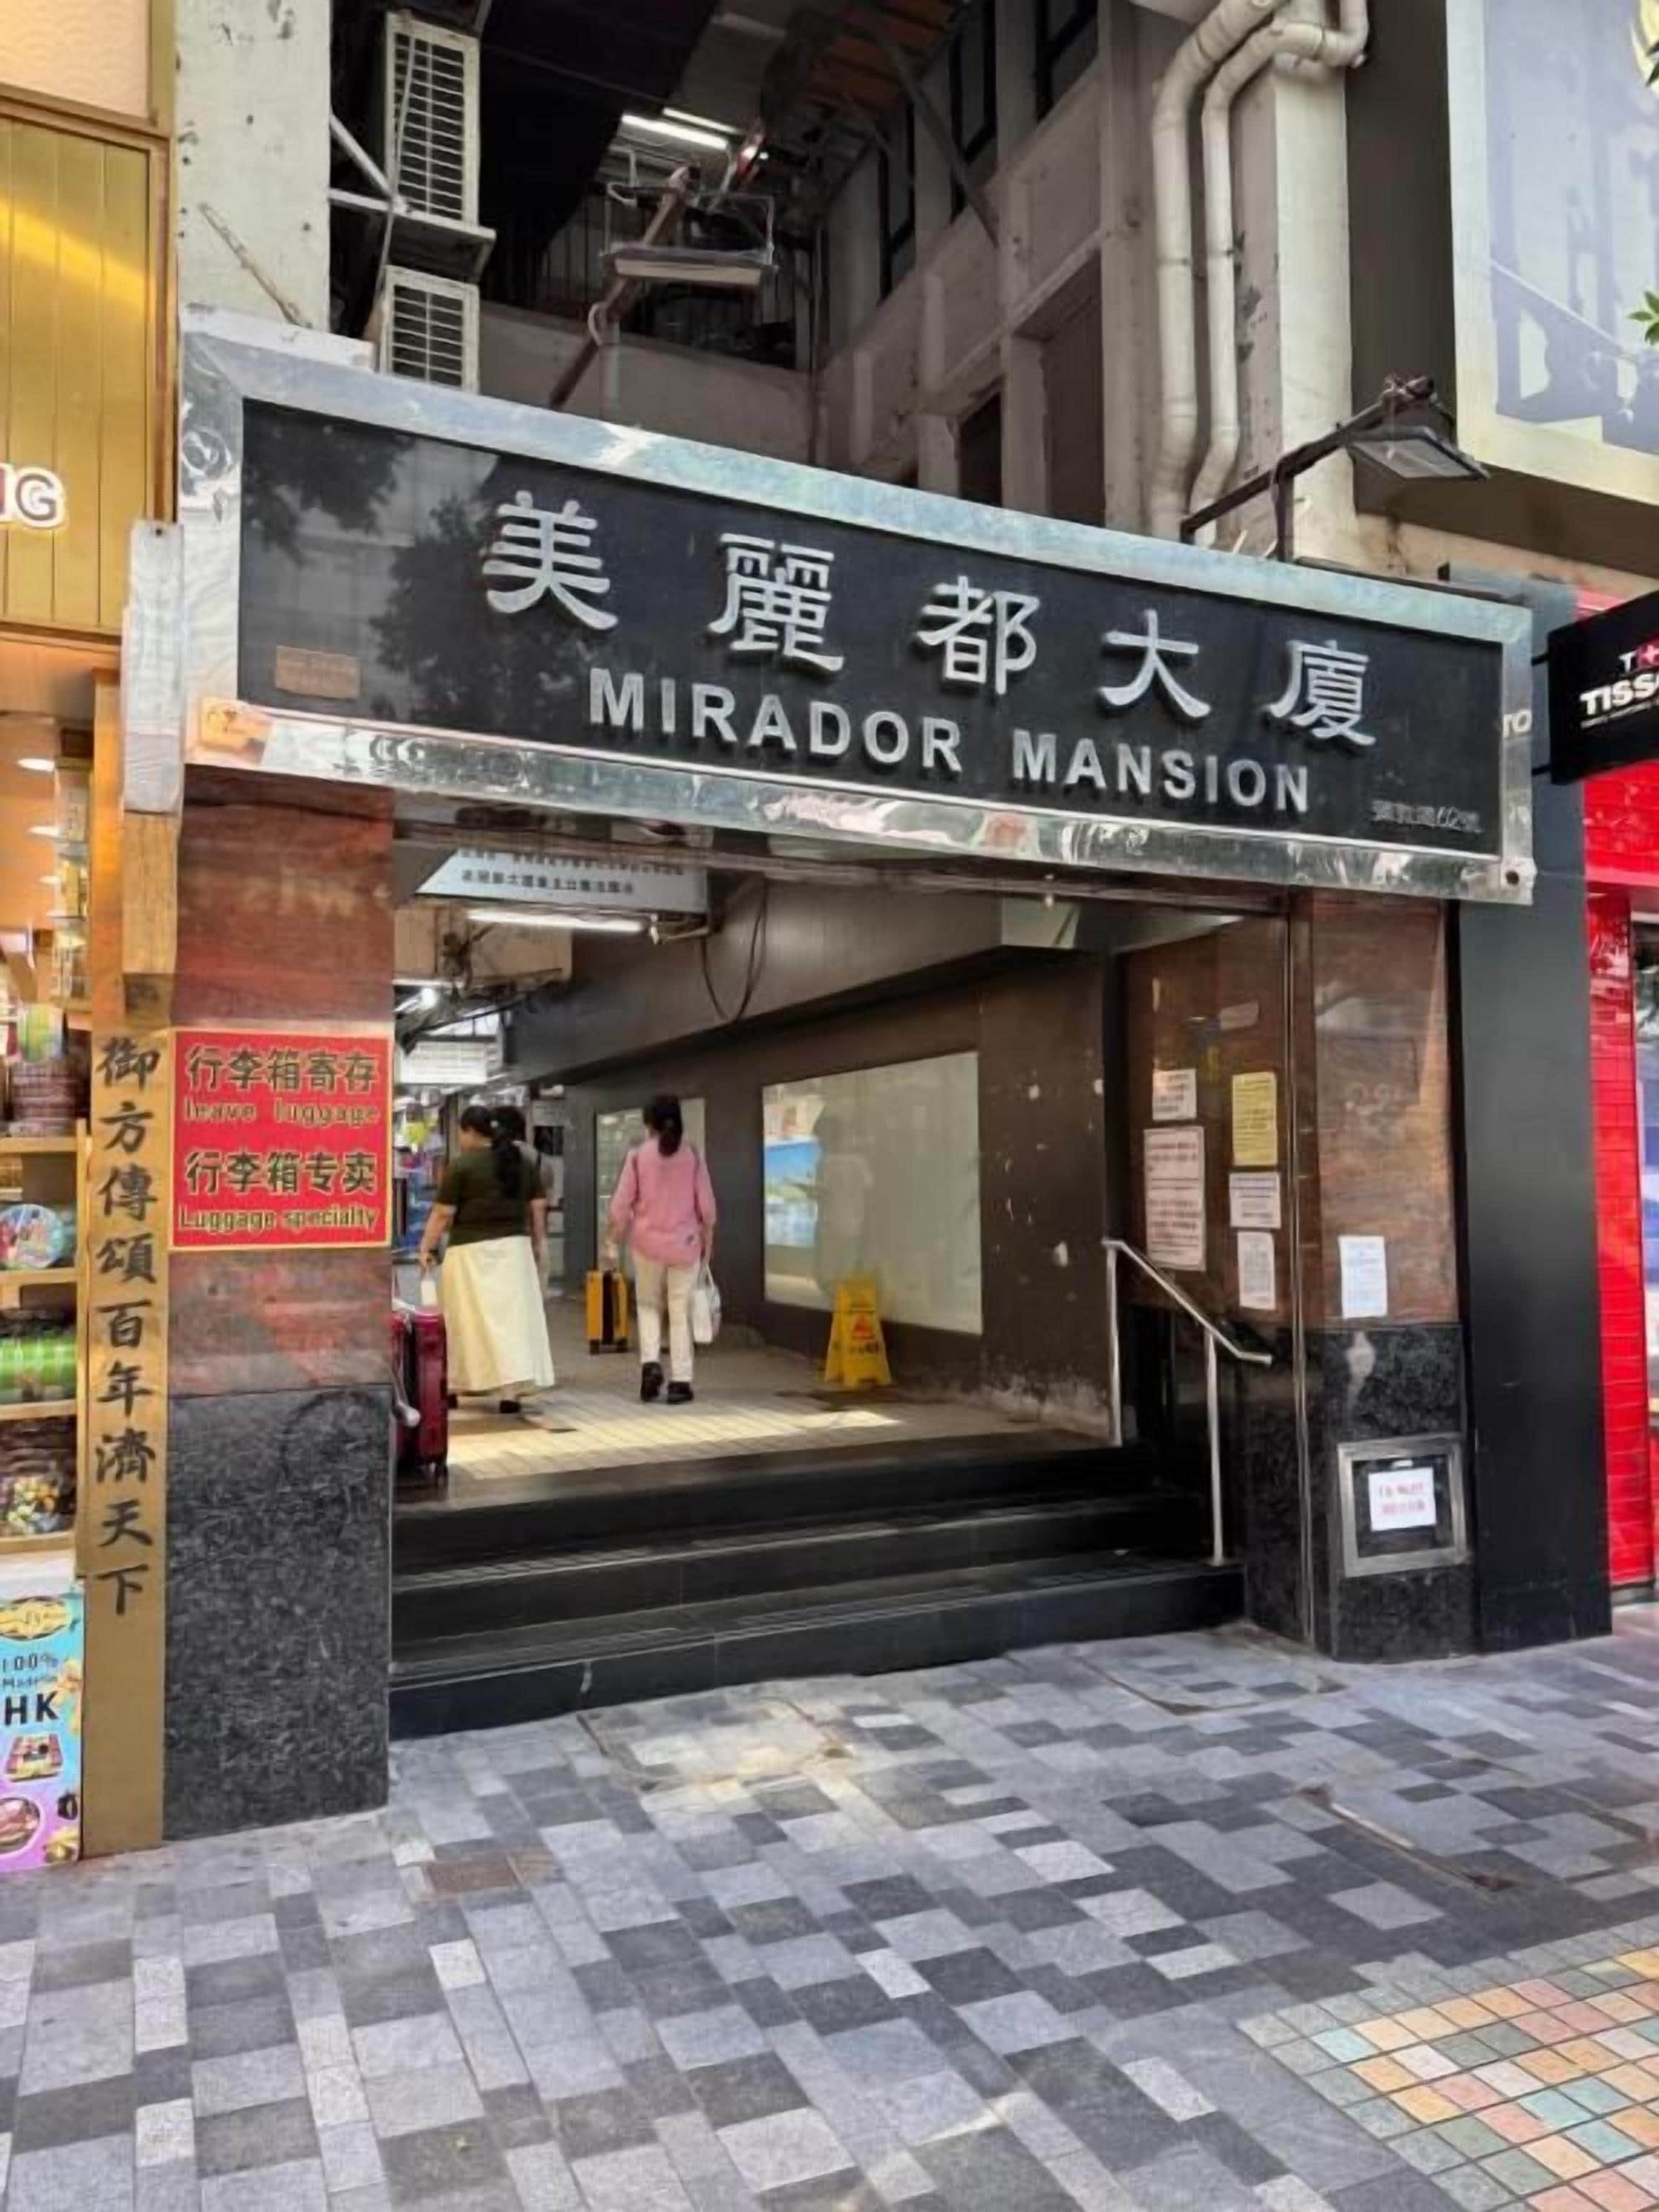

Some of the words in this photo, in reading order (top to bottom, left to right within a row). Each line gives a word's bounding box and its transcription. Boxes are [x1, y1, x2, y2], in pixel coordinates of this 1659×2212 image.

[0, 464, 65, 526] G
[482, 490, 1377, 746] 美麗都大廈
[1580, 673, 1659, 715] TISS
[590, 667, 962, 773] MIRADOR
[1013, 729, 1309, 813] MANSION
[185, 1046, 379, 1092] 行李箱寄存
[185, 1150, 379, 1195] 行李箱专卖
[4, 1690, 59, 1726] HK
